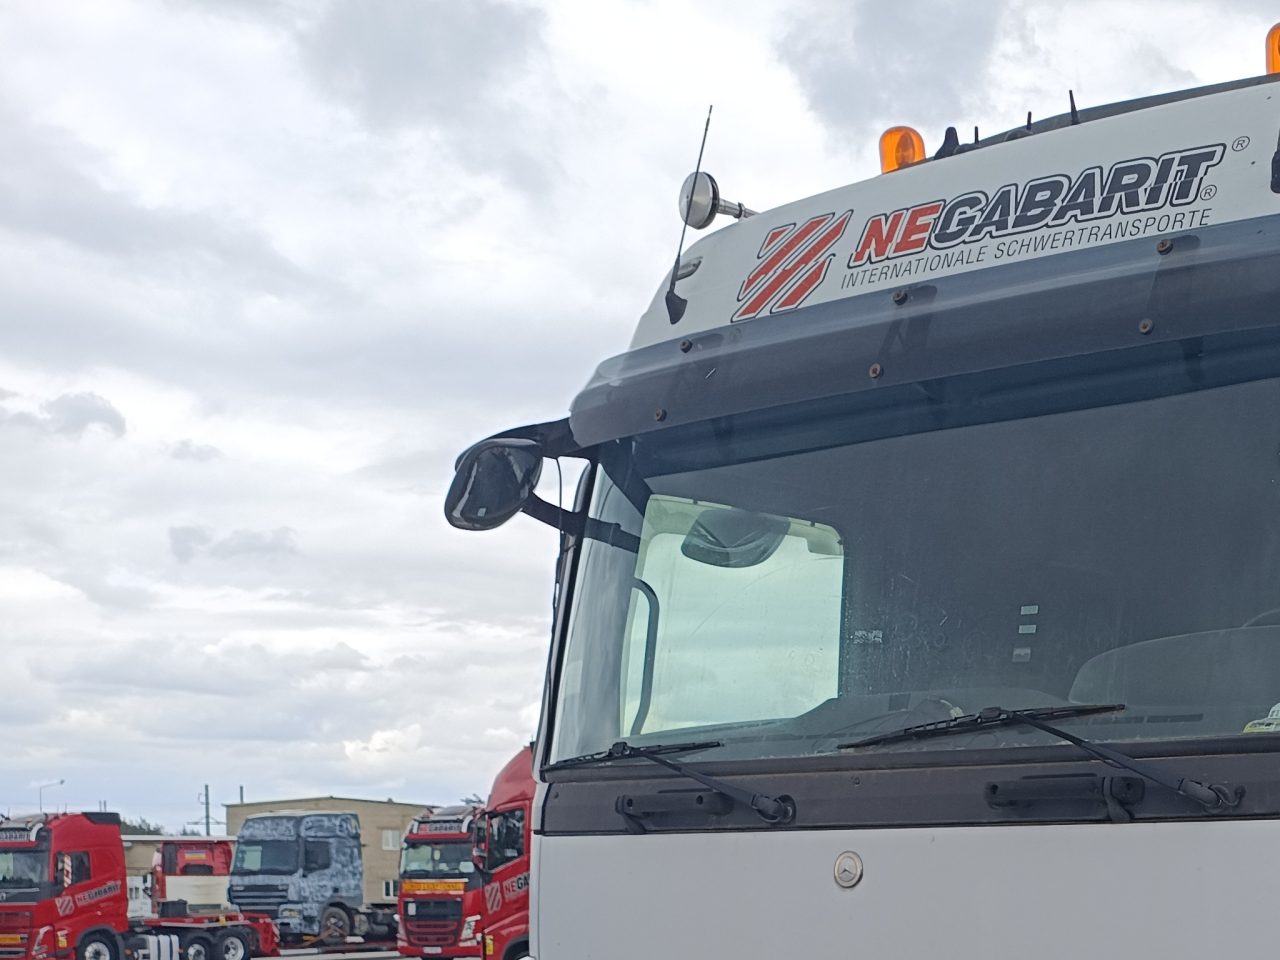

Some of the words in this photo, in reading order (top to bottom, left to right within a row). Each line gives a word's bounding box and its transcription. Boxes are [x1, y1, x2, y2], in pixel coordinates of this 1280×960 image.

[841, 246, 986, 289] INTERNATIONALE
[995, 208, 1213, 259] SCHWERTRANSPORTE
[848, 143, 1227, 268] NEGABARIT
